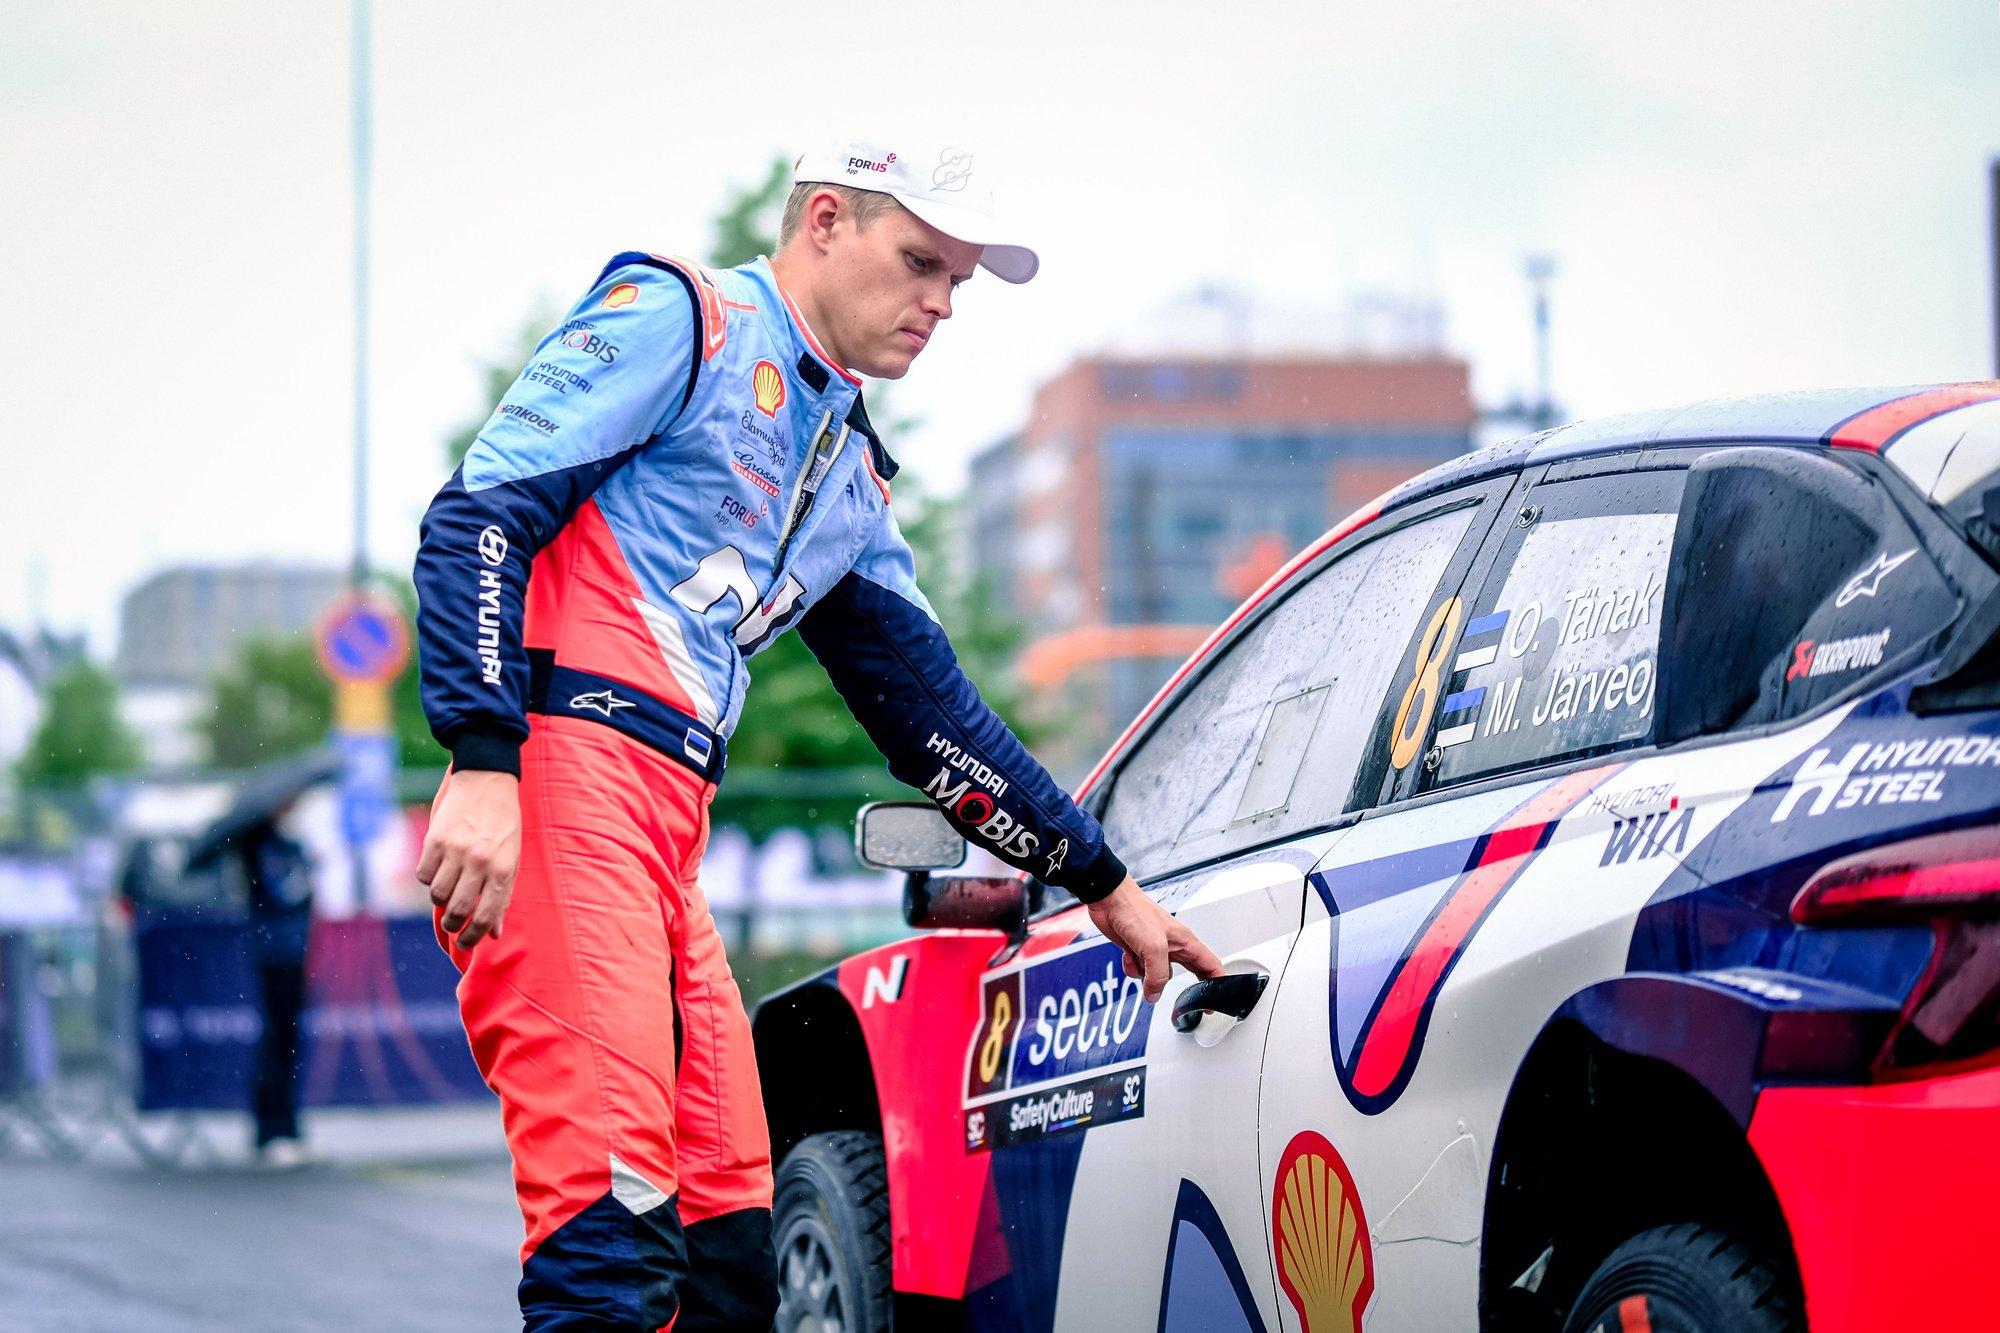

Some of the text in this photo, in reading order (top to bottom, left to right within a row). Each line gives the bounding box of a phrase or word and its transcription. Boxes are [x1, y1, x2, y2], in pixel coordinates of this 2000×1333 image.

[848, 157, 888, 173] FORUS
[529, 372, 567, 395] STEEL
[539, 362, 593, 394] HYUNDAI
[741, 410, 778, 447] Elamus
[768, 446, 787, 467] Spa
[734, 451, 782, 486] Grossi
[714, 511, 729, 526] App
[720, 495, 760, 528] FORUS
[1509, 572, 1662, 658] O. Tänak
[1391, 596, 1462, 769] 8
[1483, 676, 1524, 738] M.
[926, 732, 1009, 798] HYUNDAI
[1586, 783, 1676, 816] HYUNDAI
[1835, 769, 1947, 810] STEEL
[923, 766, 1040, 858] MOBIS
[1599, 803, 1696, 868] WIA
[1029, 961, 1144, 1066] secto
[979, 991, 1011, 1083] 8
[1122, 1075, 1140, 1105] SC
[967, 1112, 985, 1141] SC
[1009, 1090, 1094, 1133] SafetyCulture
